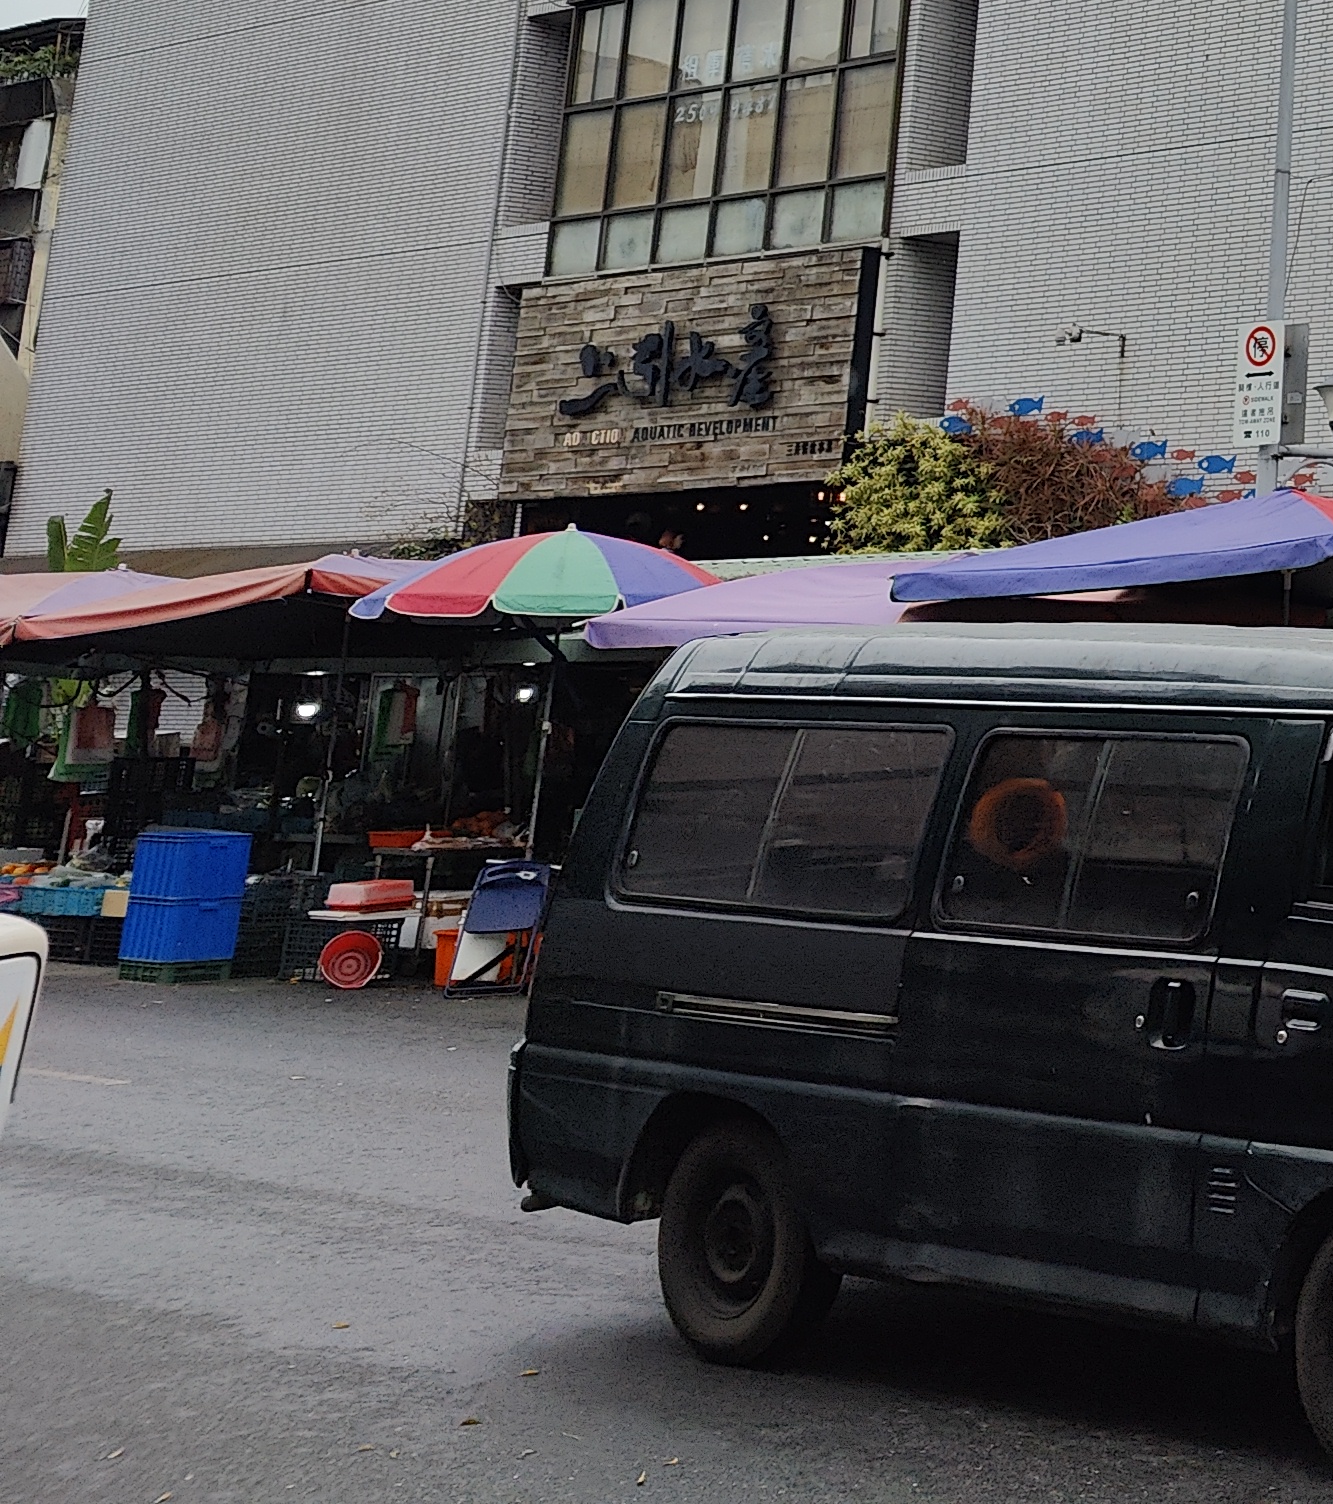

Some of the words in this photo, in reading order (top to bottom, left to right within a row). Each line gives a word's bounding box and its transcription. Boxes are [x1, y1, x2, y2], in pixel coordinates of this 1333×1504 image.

[631, 422, 684, 443] AQUATIC
[689, 415, 779, 437] DEVELOPMENT
[1256, 430, 1270, 438] 110
